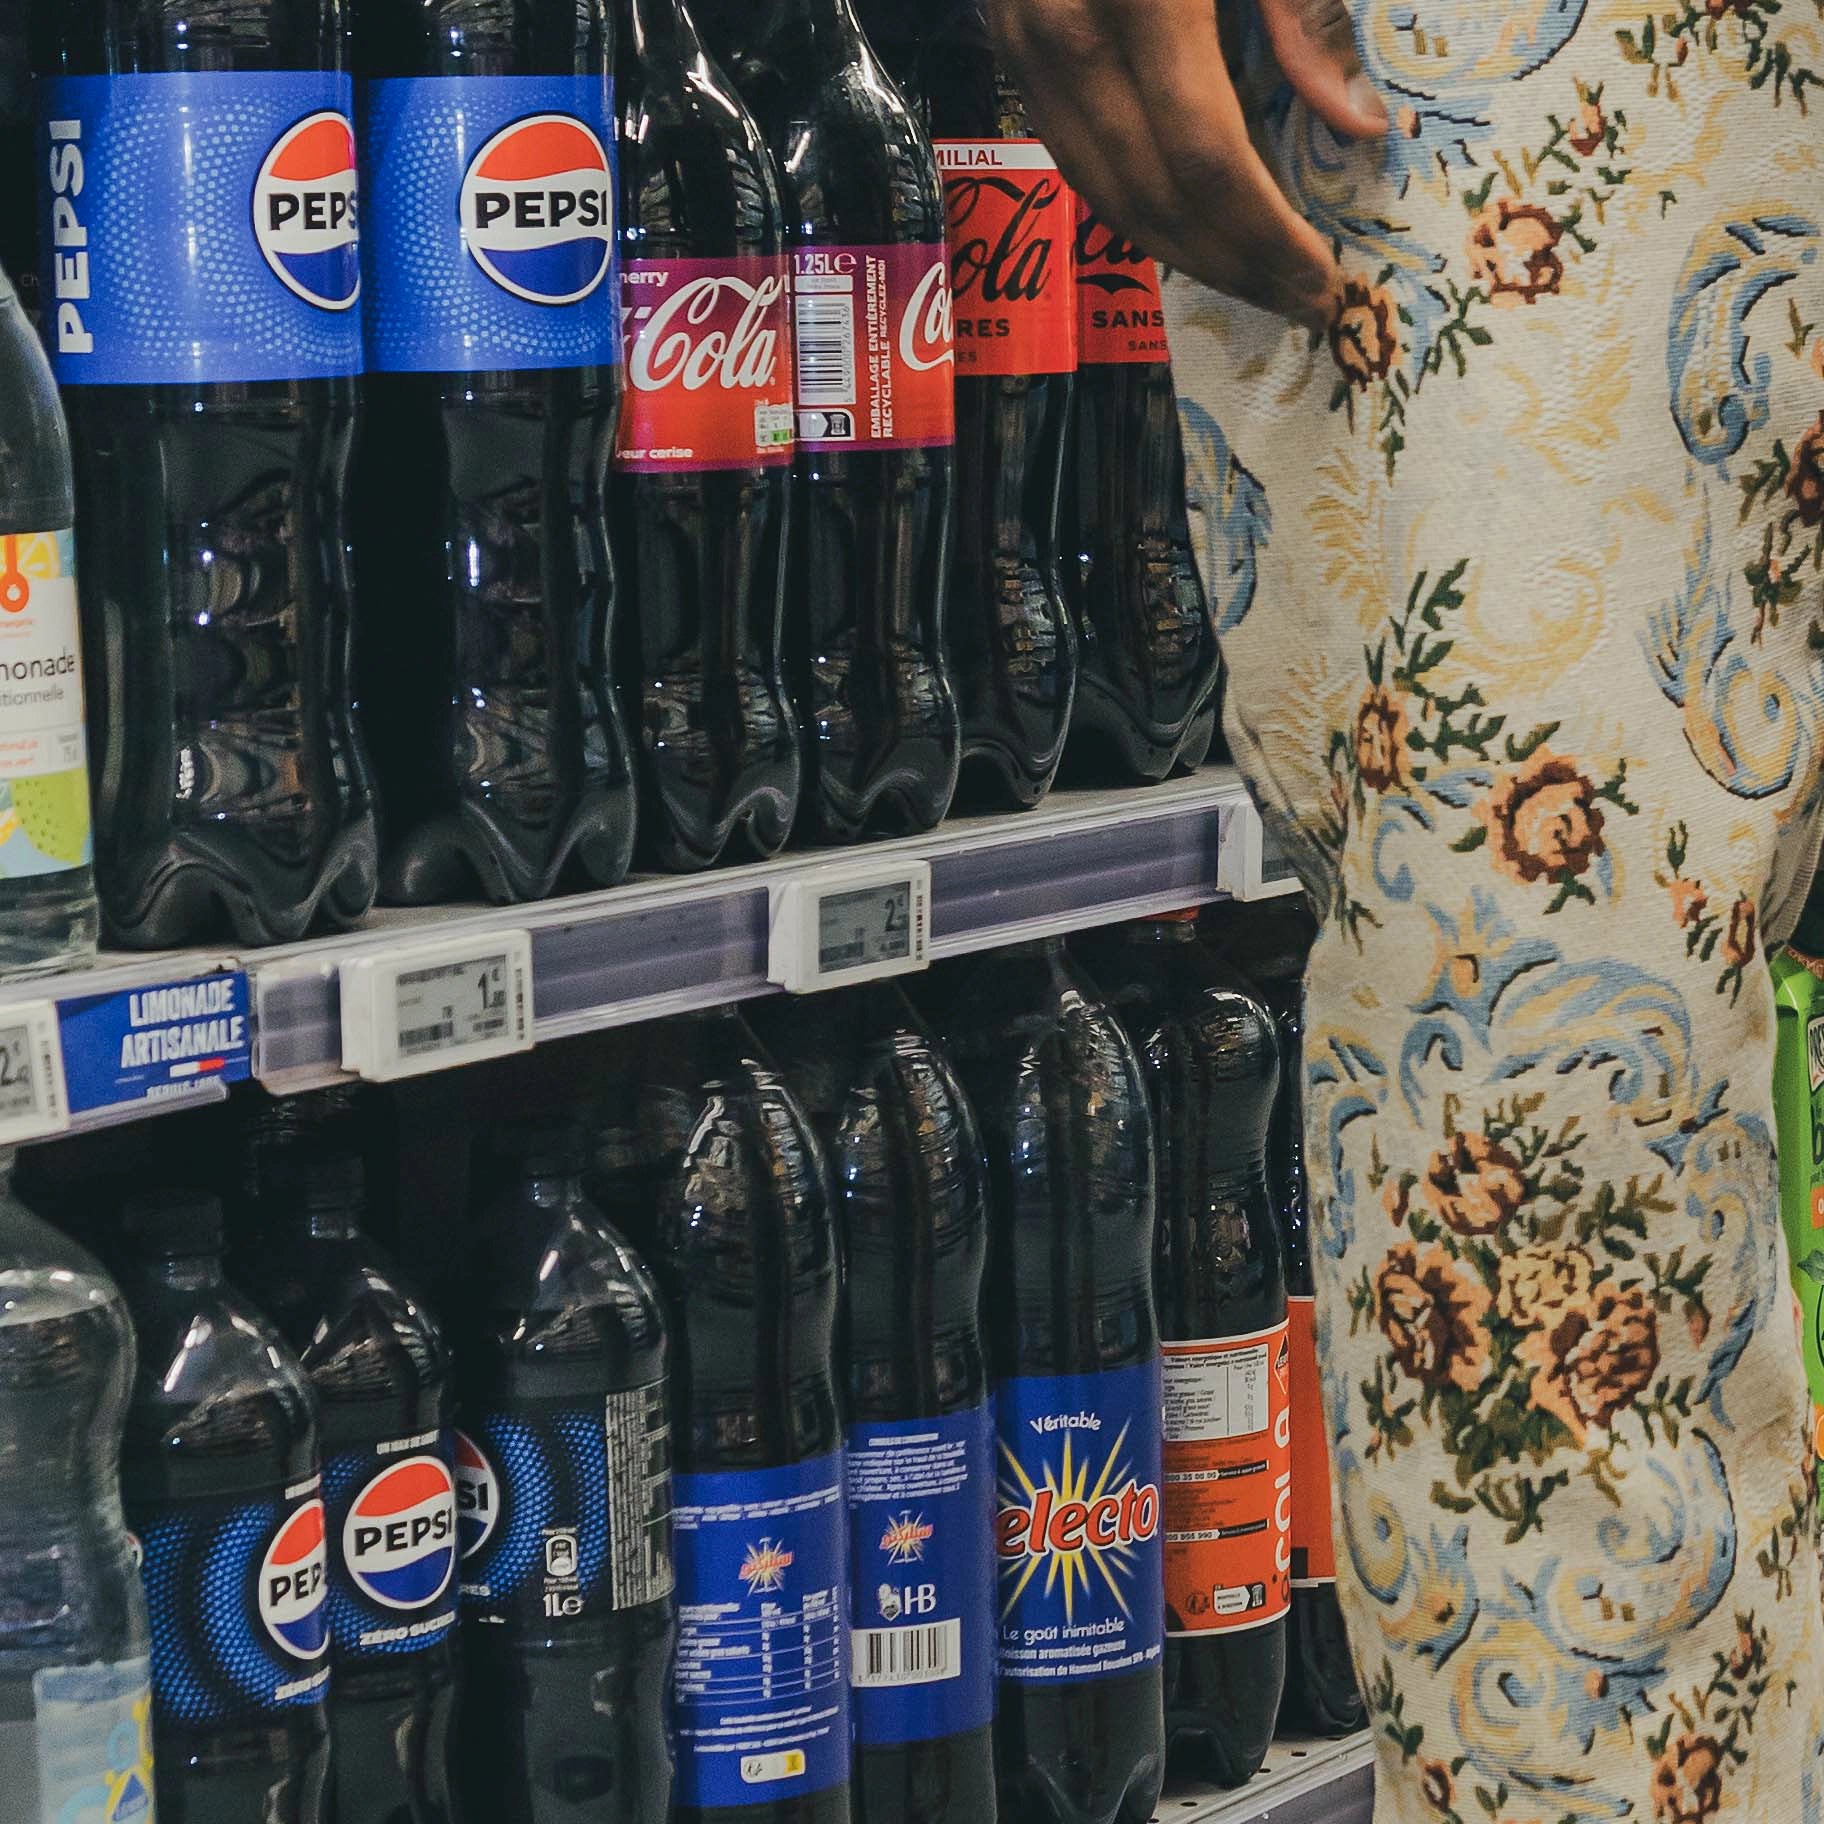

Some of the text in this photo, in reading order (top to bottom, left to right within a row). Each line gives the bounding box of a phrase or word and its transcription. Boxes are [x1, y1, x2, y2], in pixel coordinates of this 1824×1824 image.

[268, 190, 358, 232] PEPS
[474, 189, 607, 228] PEPSI
[49, 120, 94, 354] PEPSI
[956, 318, 1010, 337] RES
[1092, 310, 1163, 328] SANS
[868, 356, 881, 439] EMBALLAGE
[879, 341, 893, 438] RECYCLABLE
[649, 446, 693, 459] cerise
[885, 898, 897, 932] 2
[129, 978, 235, 1027] LIMONADE
[121, 1015, 245, 1068] ARTISANALE
[1030, 1411, 1102, 1435] Véritable
[997, 1479, 1160, 1559] electo
[270, 1562, 322, 1607] PEP
[904, 1583, 937, 1615] HB
[1003, 1617, 1125, 1645] Le goût inimitable
